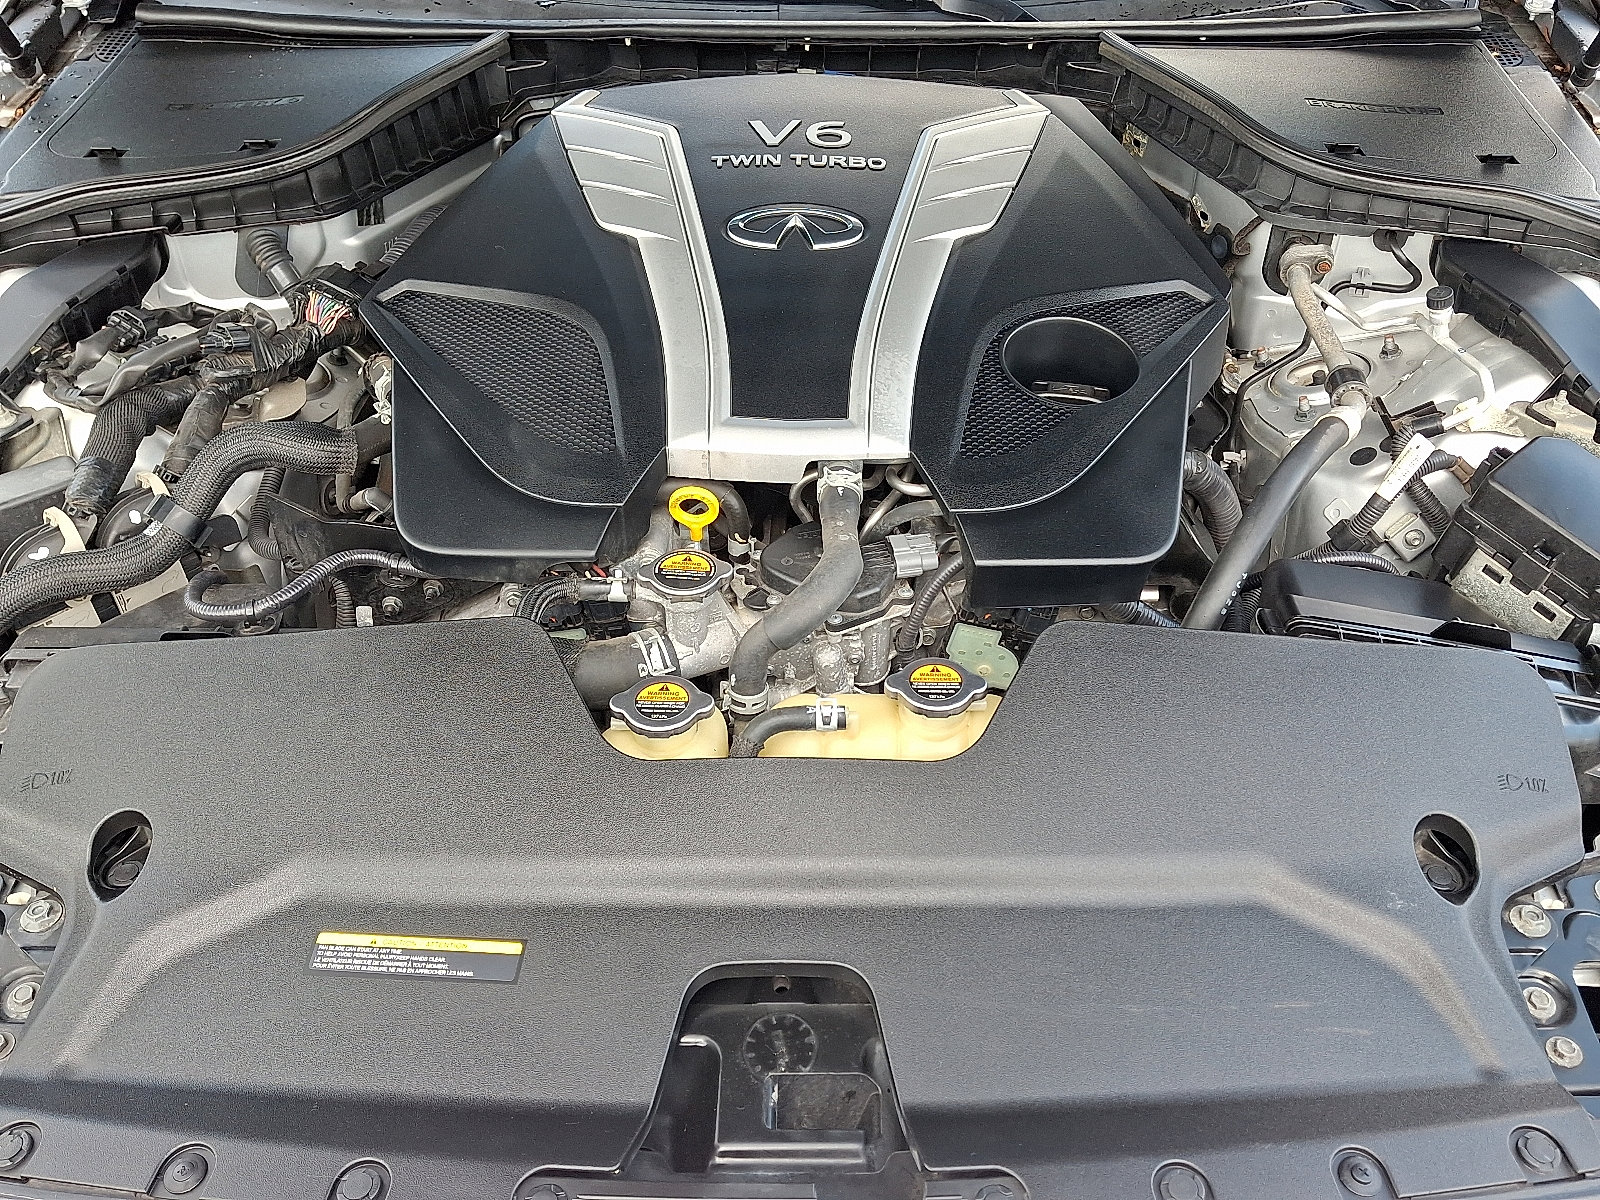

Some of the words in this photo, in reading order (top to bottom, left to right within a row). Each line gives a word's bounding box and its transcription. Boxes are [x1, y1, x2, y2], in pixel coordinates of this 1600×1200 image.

[748, 119, 852, 149] V6
[711, 154, 781, 168] TWIN
[790, 153, 887, 170] TURBO
